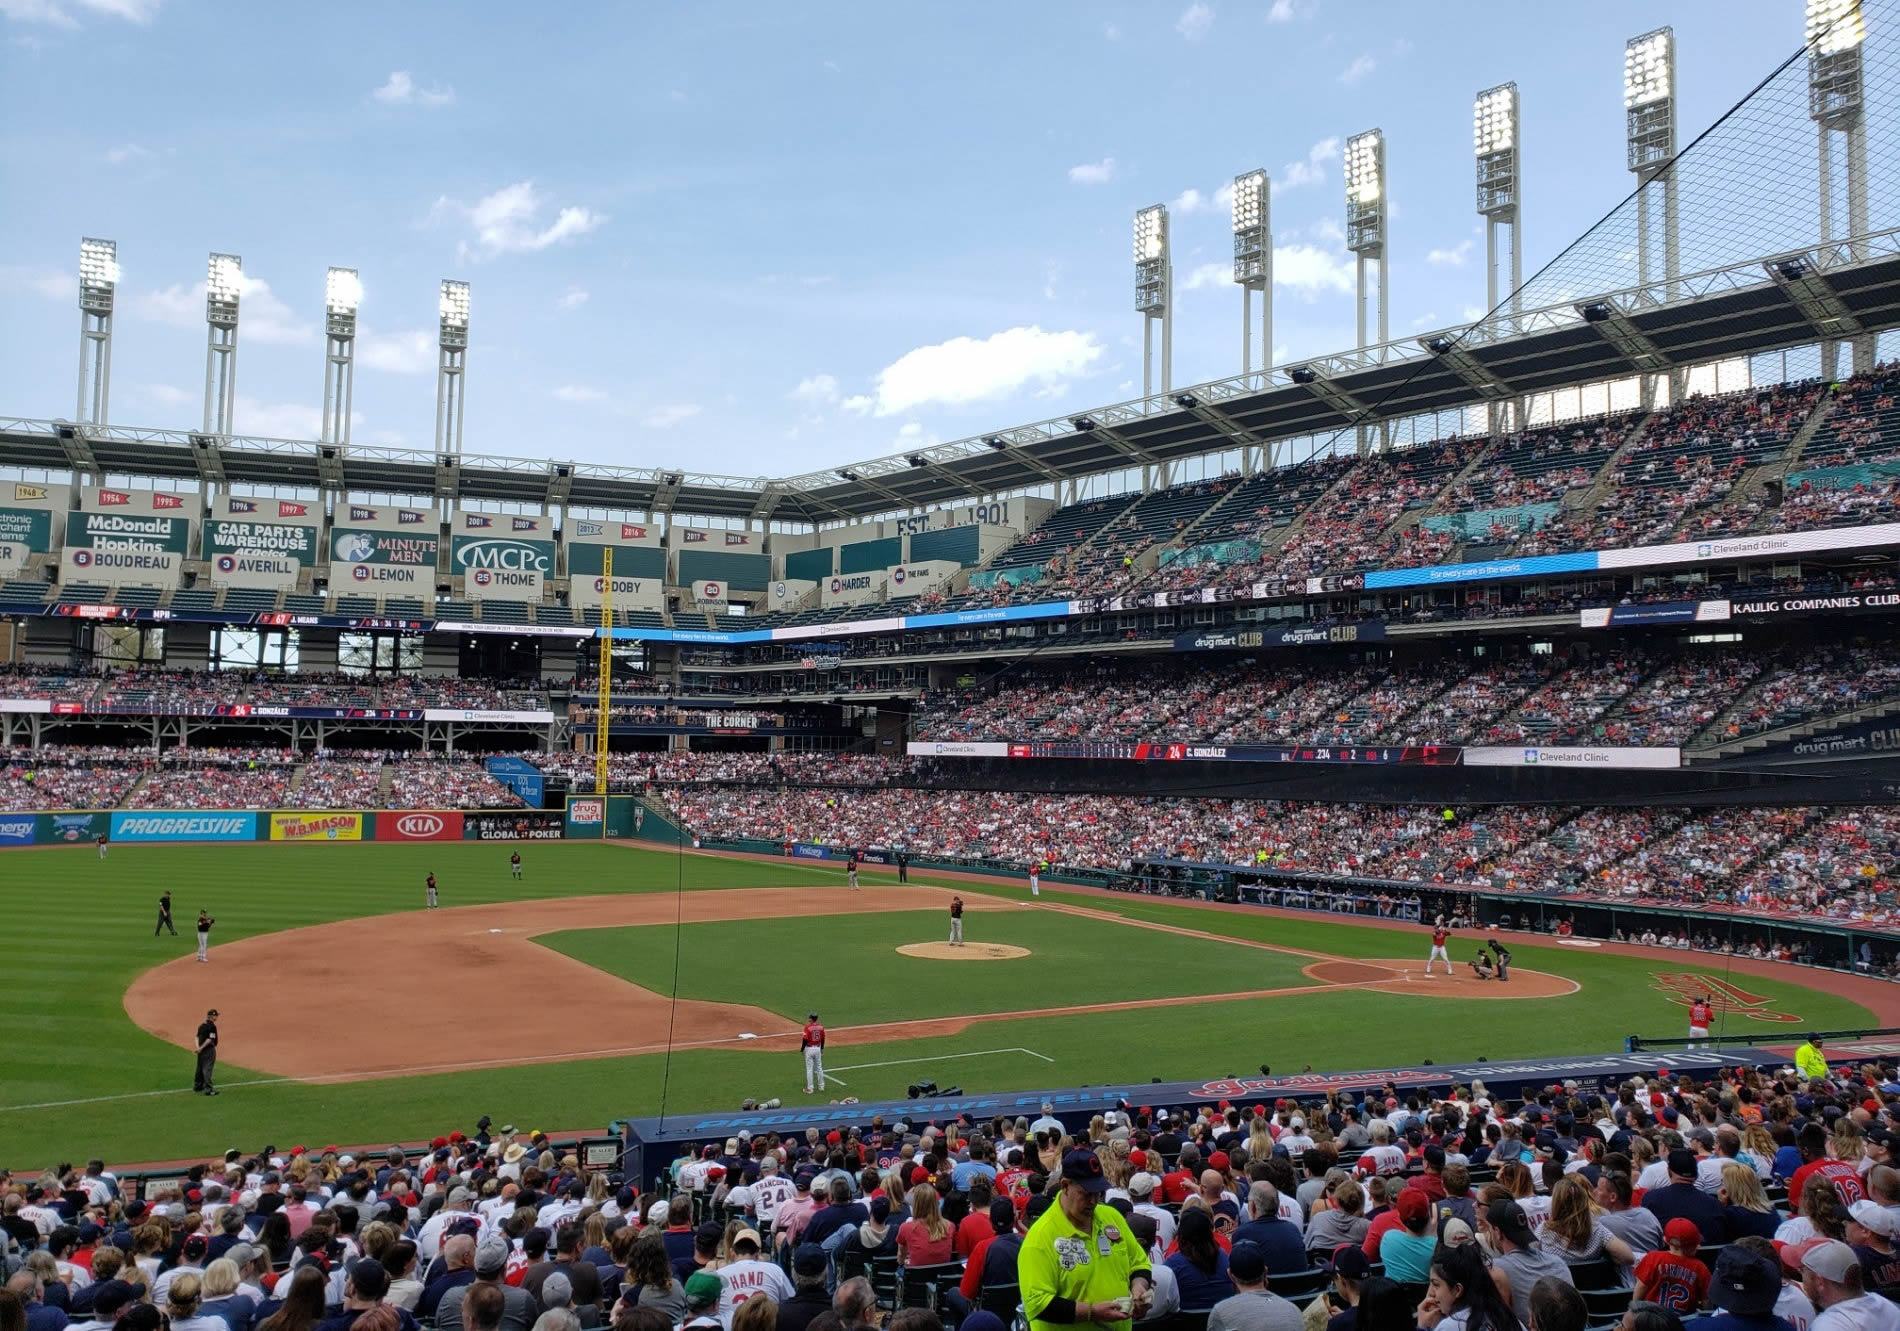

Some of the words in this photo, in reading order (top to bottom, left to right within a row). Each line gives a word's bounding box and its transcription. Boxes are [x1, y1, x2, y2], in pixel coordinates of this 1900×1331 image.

[19, 489, 37, 497] 1948
[102, 494, 120, 502] 1954
[156, 497, 174, 506] 1995
[232, 502, 248, 511] 1996
[282, 505, 298, 514] 1997
[353, 510, 369, 518] 1998
[967, 502, 1009, 525] 1901
[401, 513, 417, 521] 1999
[468, 517, 484, 526] 2001
[87, 515, 171, 533] McDonald
[218, 523, 250, 535] CAR
[254, 525, 304, 538] PARTS
[514, 520, 530, 529] 2007
[624, 528, 639, 537] 2016
[93, 536, 163, 552] Hopkins
[214, 534, 308, 550] WAREHOUSE
[377, 538, 436, 552] MINUTE
[1714, 540, 1759, 553] Cleveland
[1761, 539, 1789, 549] Clinic
[78, 554, 87, 563] 5
[94, 554, 170, 569] BOUDREAU
[389, 550, 423, 562] MEN
[223, 560, 230, 569] 3
[238, 560, 292, 573] AVERILL
[356, 569, 367, 577] 21
[371, 568, 415, 582] LEMON
[477, 573, 489, 582] 25
[494, 573, 535, 586] THOME
[612, 581, 641, 593] DOBY
[707, 586, 718, 594] 20
[842, 577, 870, 590] HARDER
[1733, 601, 1779, 614] KAULIG
[1784, 597, 1860, 610] COMPANIES
[1866, 594, 1900, 606] CLUB
[275, 615, 286, 624] 67
[298, 617, 318, 625] MEANS
[1195, 639, 1214, 648] drug
[1215, 636, 1236, 646] mart
[1238, 632, 1263, 647] CLUB
[1282, 632, 1303, 643] drug
[1303, 630, 1328, 641] mart
[1330, 626, 1357, 641] CLUB
[801, 657, 815, 670] kids
[235, 706, 245, 716] 24
[258, 705, 289, 715] GONZÁLEZ
[706, 716, 722, 728] THE
[724, 716, 757, 728] CORNER
[1170, 747, 1180, 758] 24
[1186, 748, 1193, 757] C.
[1194, 746, 1226, 757] GONZÁLEZ
[1793, 742, 1828, 755] drug
[1830, 736, 1866, 750] mart
[1540, 752, 1581, 762] Cleveland
[1584, 752, 1609, 762] Clinic
[572, 801, 597, 814] drug
[574, 813, 600, 821] mart
[118, 818, 246, 835] PROGRESSIVE
[405, 819, 434, 833] KIA
[481, 830, 519, 839] GLOBAL
[529, 830, 561, 839] POKER
[864, 853, 884, 863] Fanatics
[1450, 1060, 1620, 1076] ESTABLISHED
[1605, 1052, 1753, 1067] 1901
[1189, 1070, 1453, 1098] Indians
[695, 1099, 1001, 1129] PROGRESSIVE
[1015, 1091, 1130, 1108] FIELD
[1089, 1157, 1100, 1173] C
[762, 1189, 787, 1210] 24
[1835, 1180, 1861, 1208] 12
[730, 1271, 764, 1290] HAND
[1659, 1281, 1690, 1314] 12
